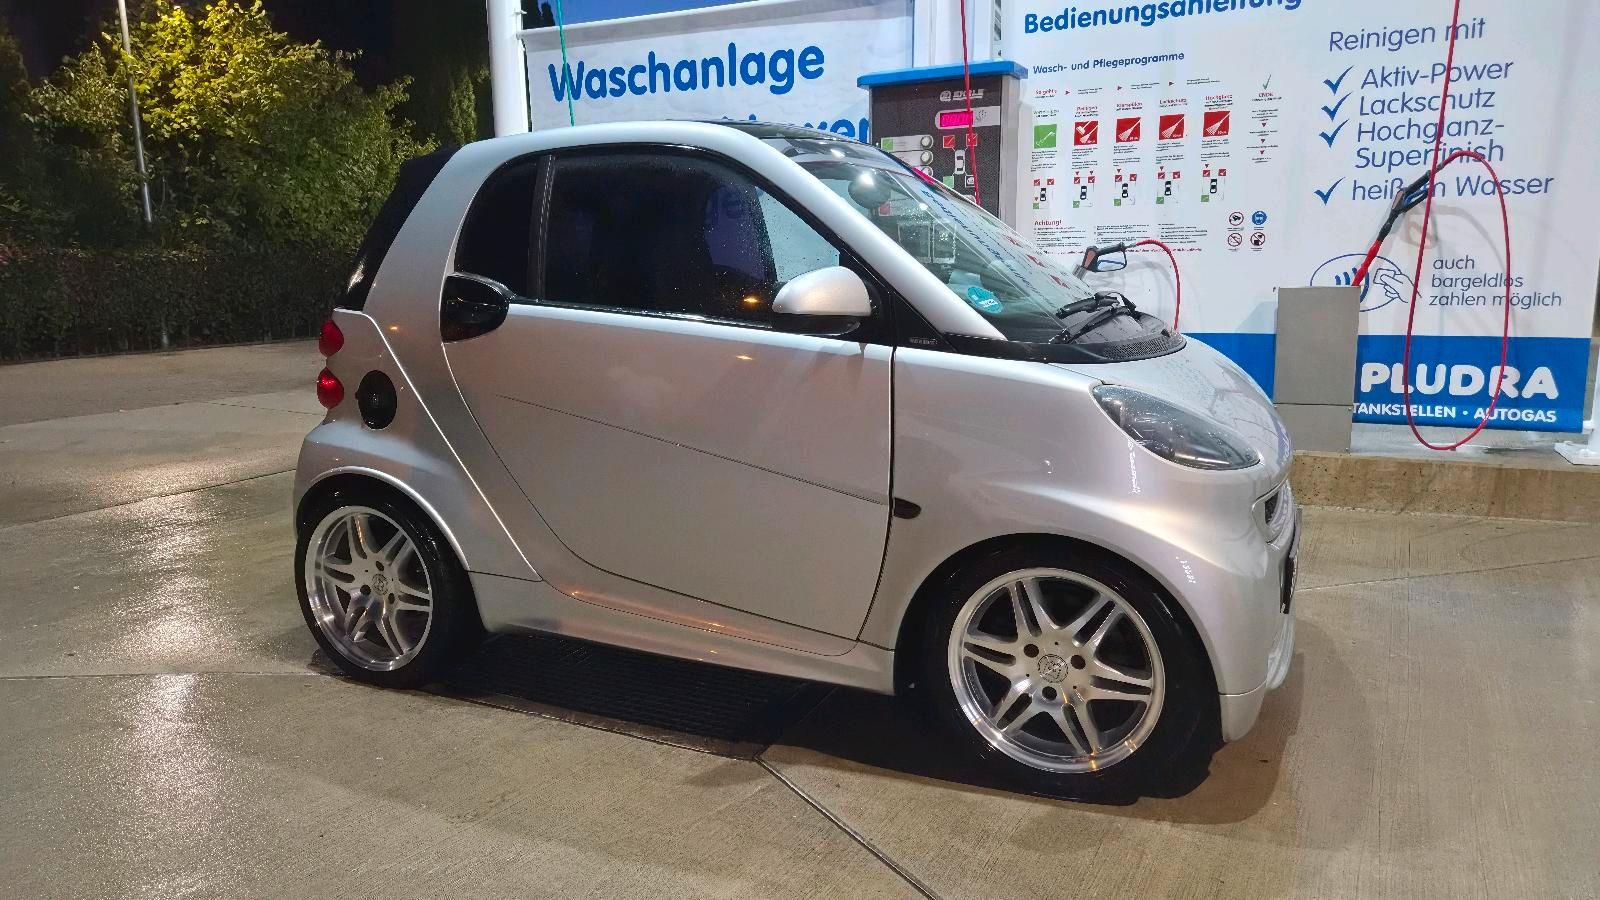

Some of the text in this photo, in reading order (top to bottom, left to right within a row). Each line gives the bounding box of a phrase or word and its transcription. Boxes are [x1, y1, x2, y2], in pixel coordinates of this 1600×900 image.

[1329, 18, 1486, 52] Reinigen mit
[548, 42, 825, 103] Waschanlage
[1033, 51, 1185, 75] Wasch- und Pflegeprogramme
[1361, 60, 1514, 90] Aktiv-Power
[1359, 88, 1496, 117] Lackschutz
[1357, 118, 1505, 144] Hochglanz-
[1456, 175, 1555, 198] Wasser
[1034, 219, 1062, 227] Achtung!
[1433, 255, 1475, 270] auch
[1432, 272, 1524, 292] bargeldlos
[1429, 291, 1562, 310] zahlen möglich
[1360, 362, 1560, 400] PLUDRA
[1352, 402, 1557, 423] TANKSTELLEN AUTOGAS
